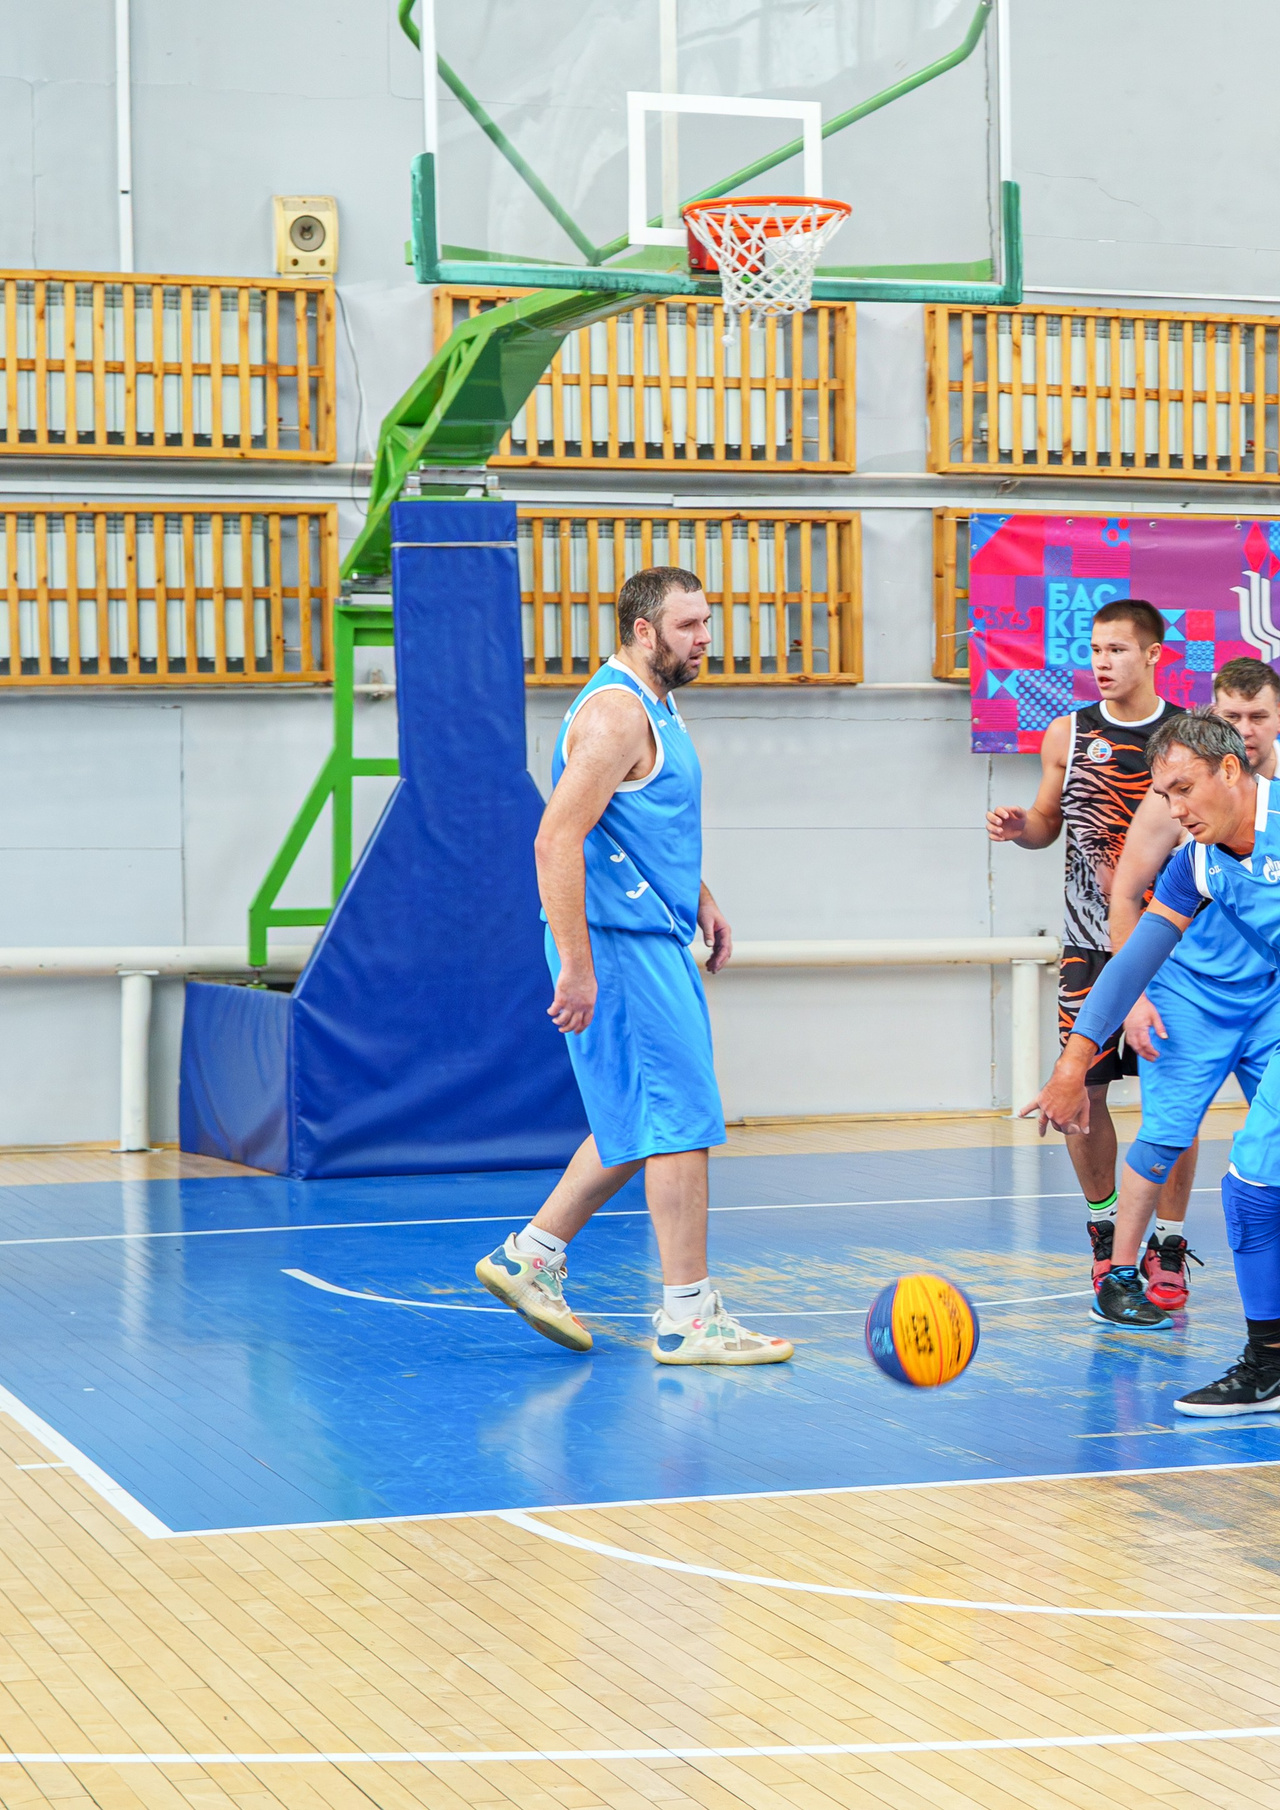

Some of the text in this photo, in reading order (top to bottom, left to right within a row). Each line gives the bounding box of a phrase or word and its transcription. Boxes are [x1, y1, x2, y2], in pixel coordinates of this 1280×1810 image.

[1048, 583, 1118, 610] БАС
[1049, 611, 1097, 638] КЕ
[1048, 638, 1092, 665] БО
